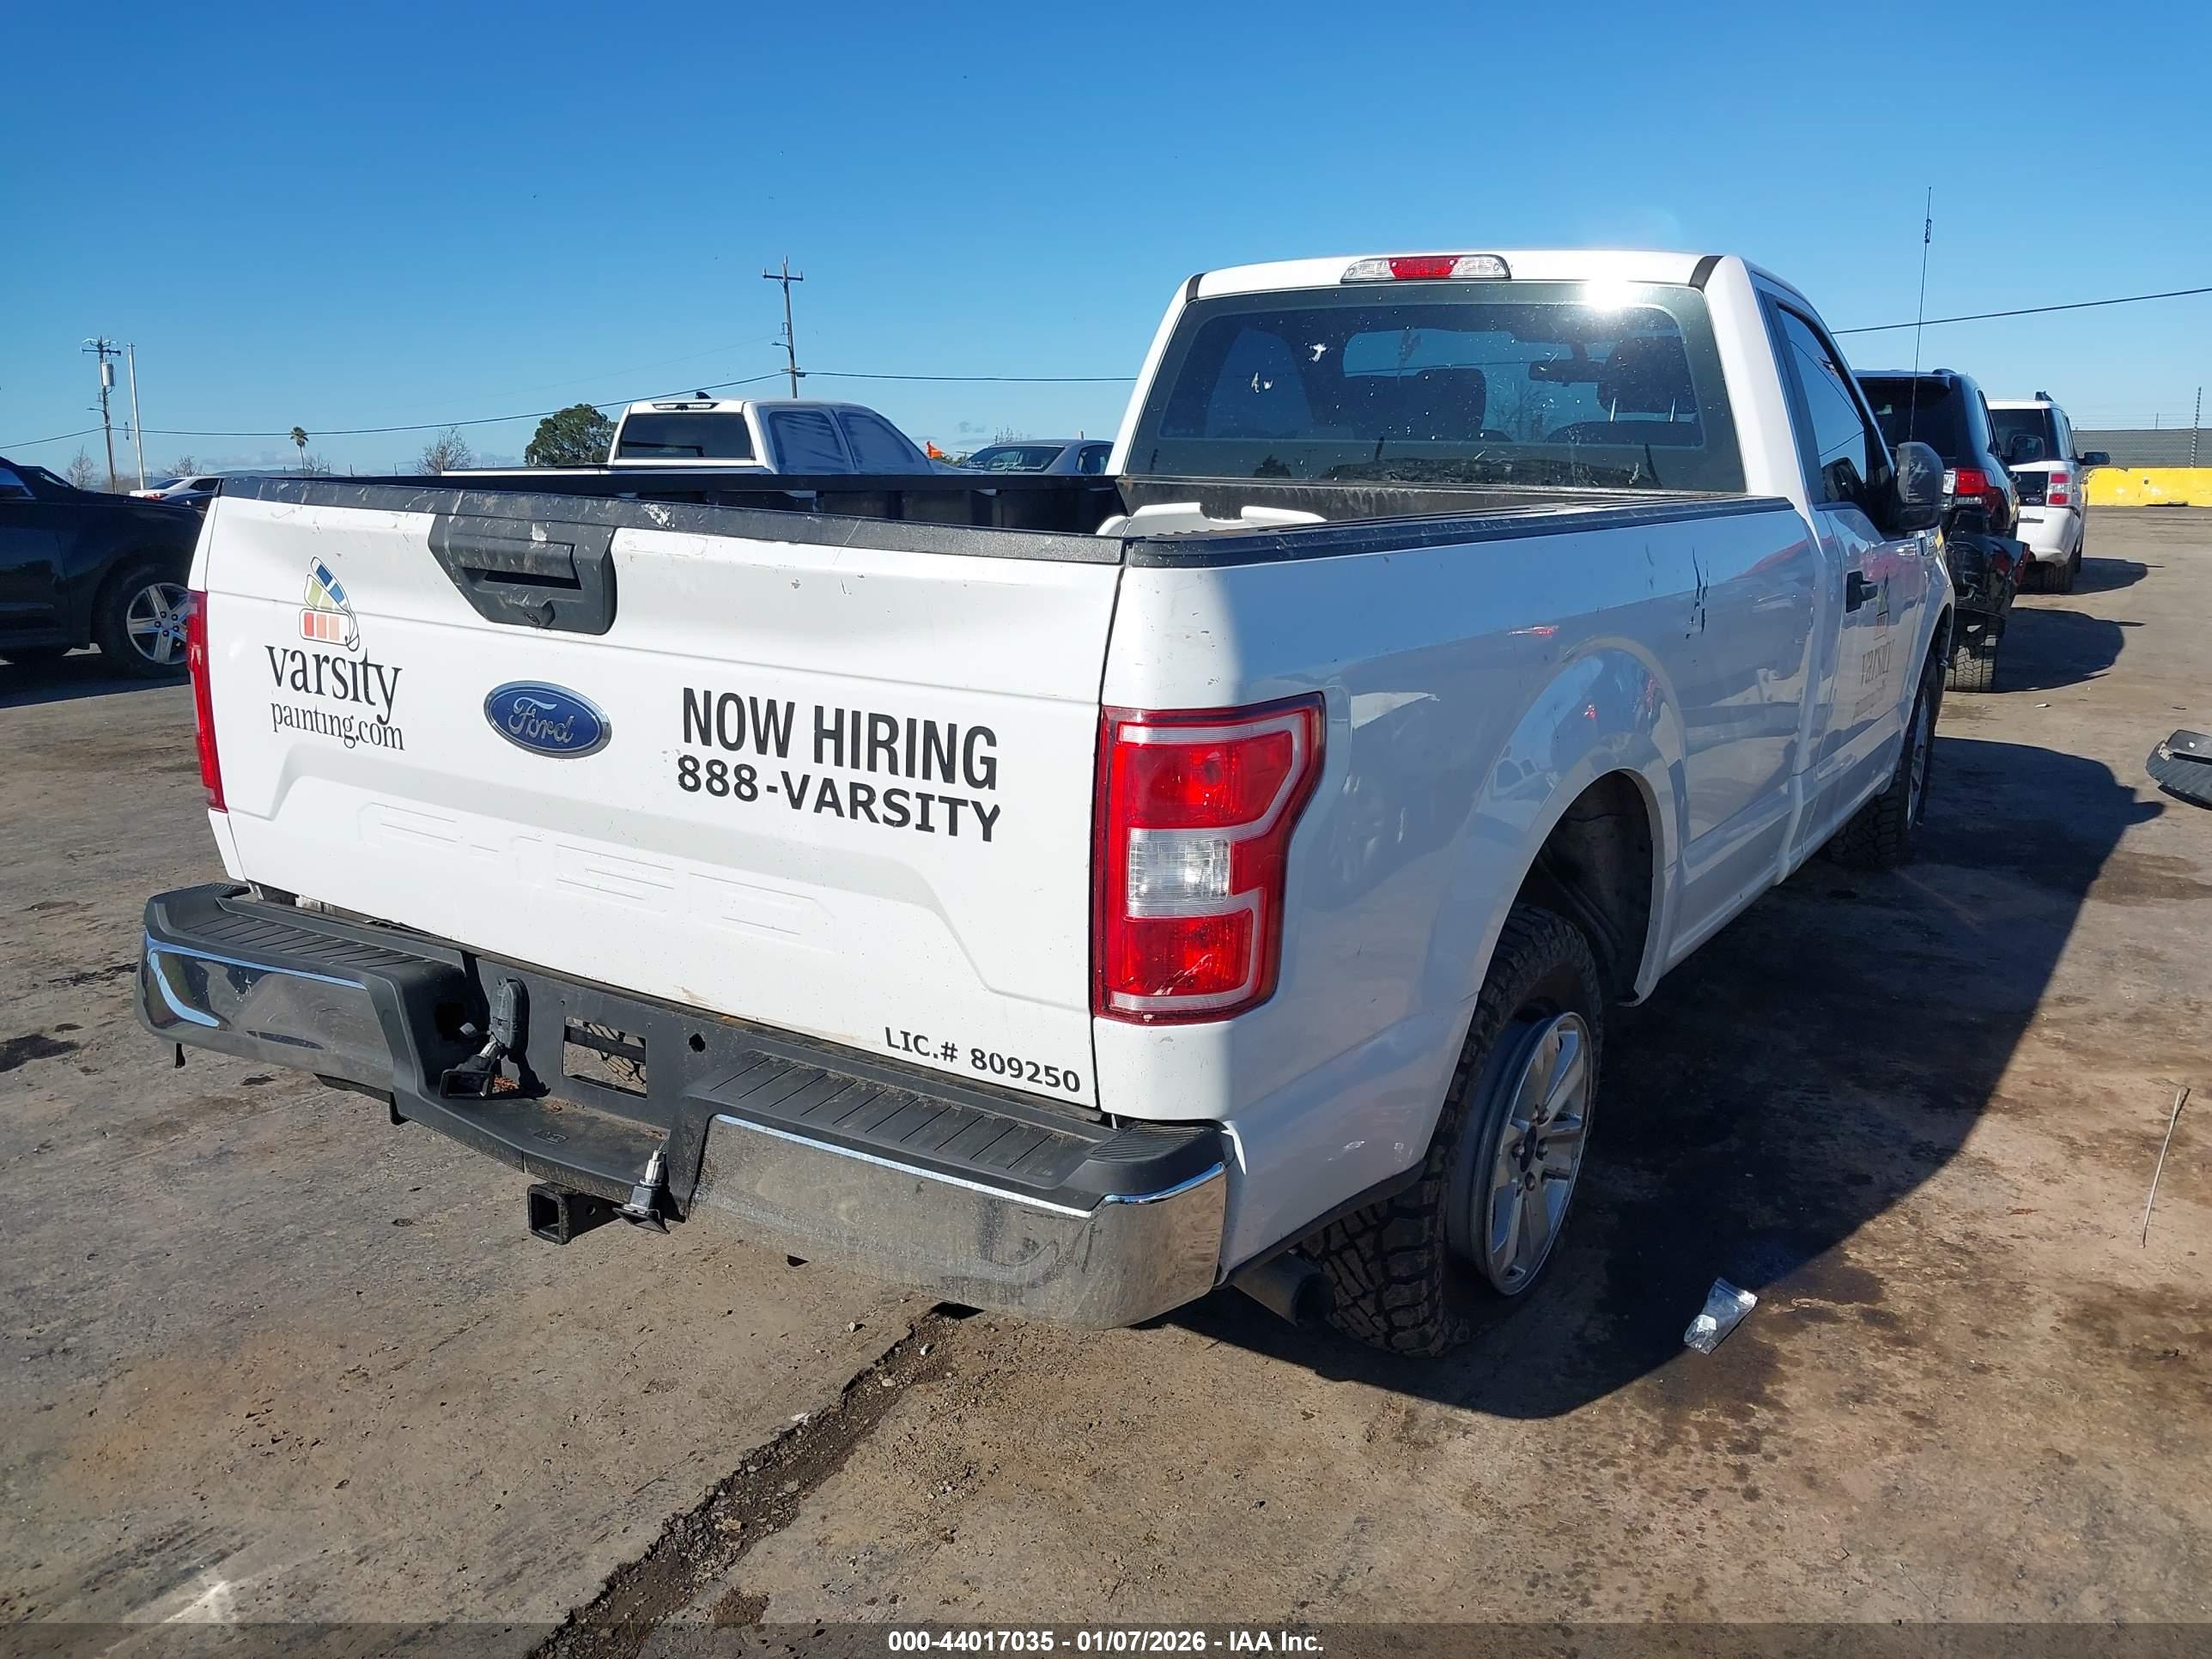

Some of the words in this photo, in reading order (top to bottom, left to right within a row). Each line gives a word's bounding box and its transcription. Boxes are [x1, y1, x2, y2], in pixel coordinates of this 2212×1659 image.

[264, 645, 403, 726] varsity
[507, 696, 574, 744] Ford
[270, 703, 405, 750] painting.com
[683, 687, 795, 758] NOW
[813, 705, 997, 791] HIRING
[677, 754, 1001, 842] 888-VARSITY
[884, 1026, 958, 1064] LIC.#
[970, 1048, 1080, 1093] 809250
